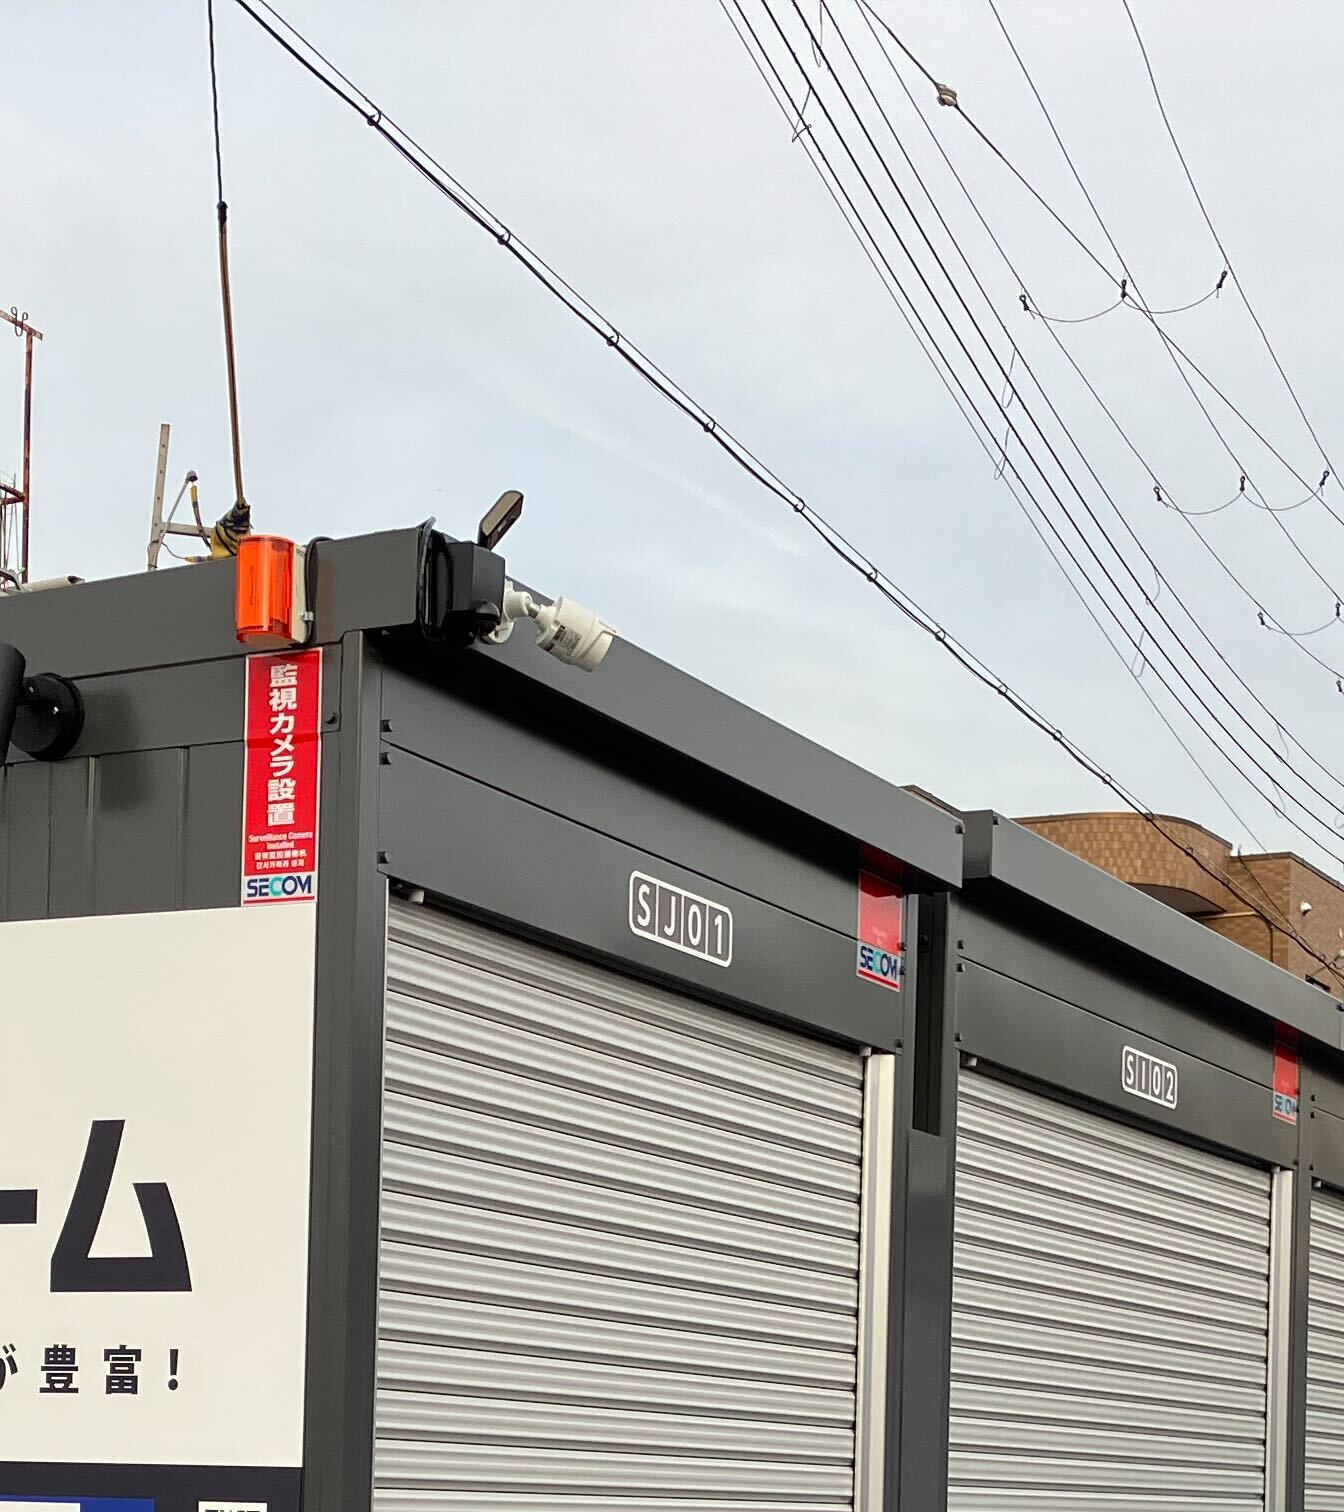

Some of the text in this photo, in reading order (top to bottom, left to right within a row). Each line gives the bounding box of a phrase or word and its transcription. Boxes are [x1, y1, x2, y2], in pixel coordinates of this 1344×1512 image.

[267, 664, 298, 827] 監視カメラ設置
[247, 875, 312, 897] SECOM
[860, 945, 898, 980] SECOM
